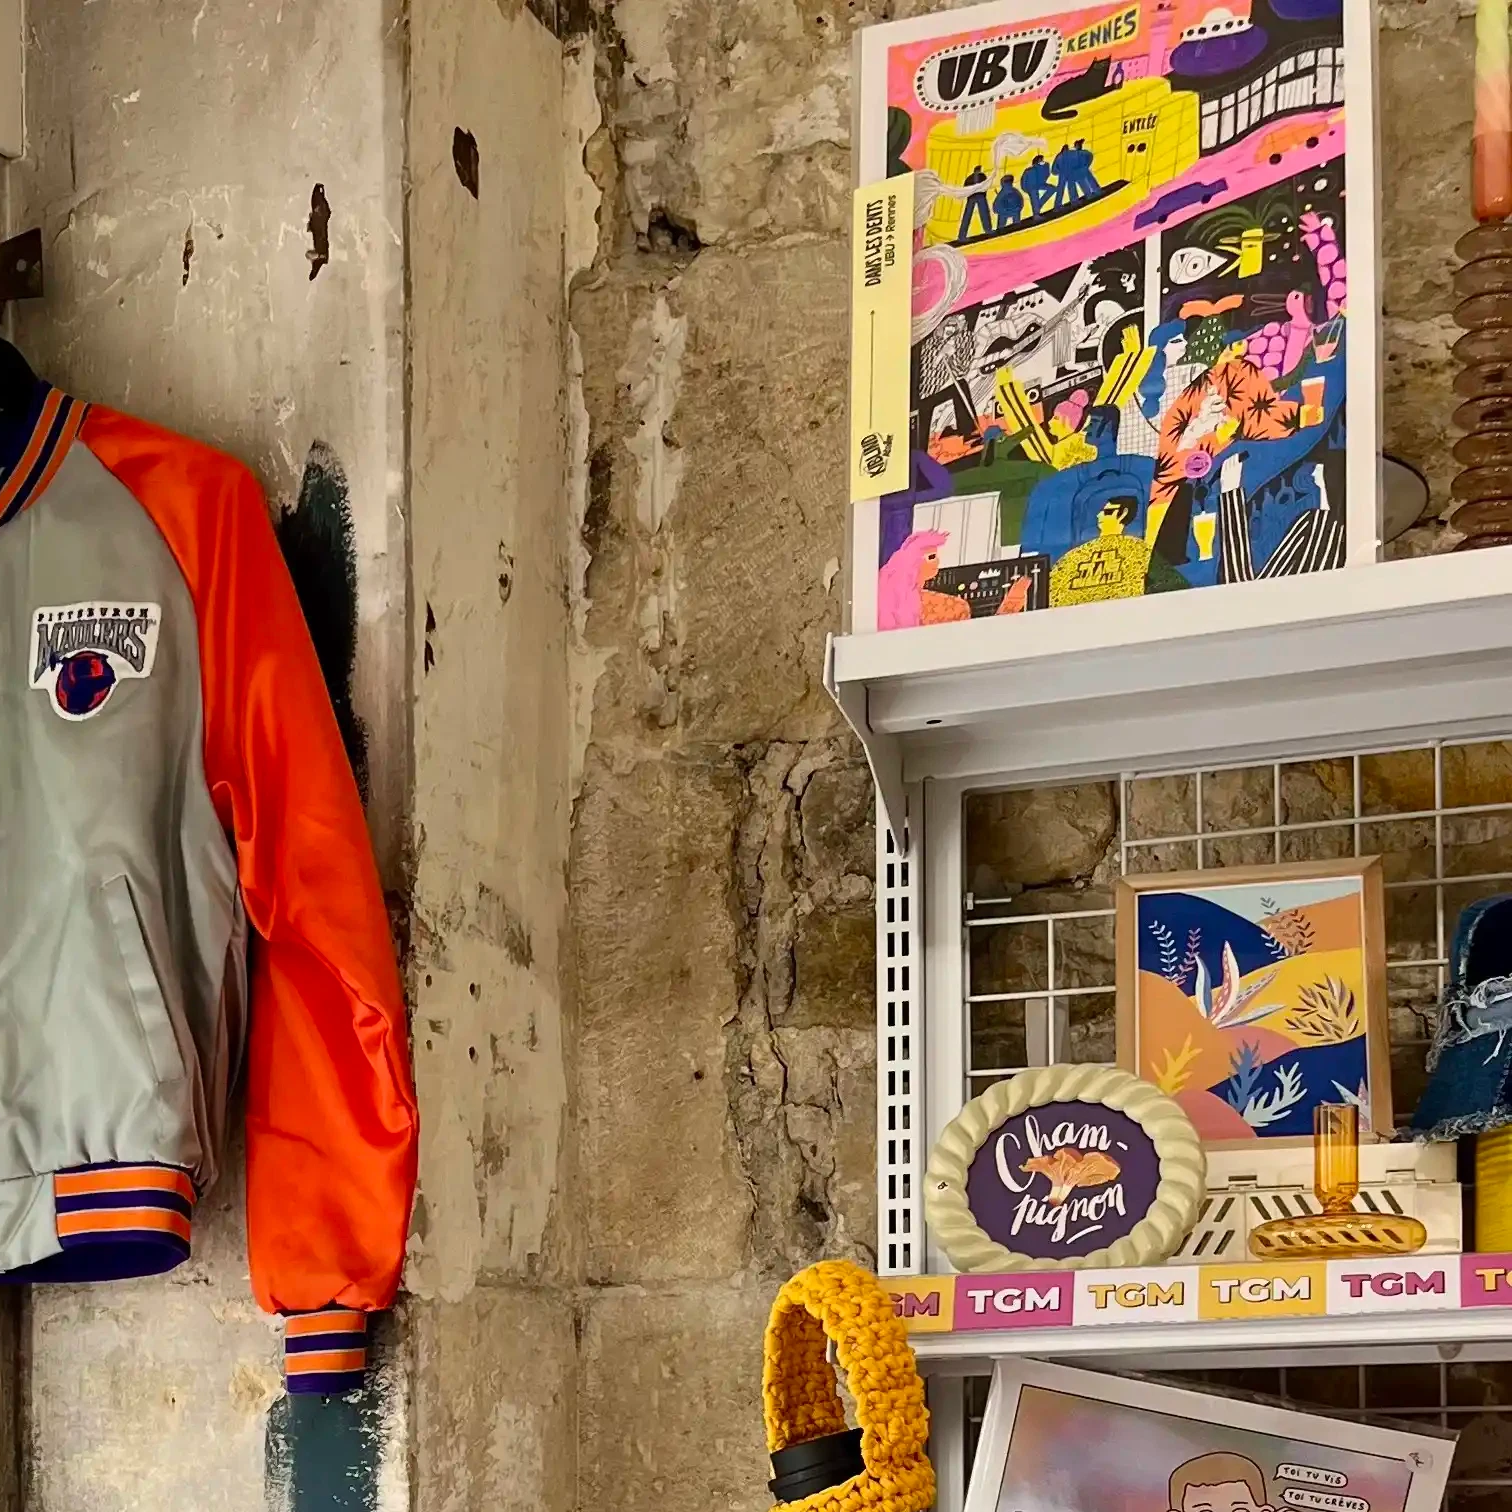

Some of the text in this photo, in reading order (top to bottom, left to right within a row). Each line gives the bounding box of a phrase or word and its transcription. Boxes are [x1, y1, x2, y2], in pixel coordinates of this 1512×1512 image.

[938, 38, 1049, 101] UBU
[864, 199, 883, 287] DANS LES DENTS
[860, 434, 886, 478] KIBLIND
[38, 607, 149, 622] PITTSBURGH
[34, 618, 148, 684] MAULERS
[1010, 1183, 1127, 1242] pignon
[966, 1285, 1059, 1313] TGM
[1088, 1280, 1185, 1309] TGM
[1211, 1275, 1312, 1304] TGM
[1341, 1270, 1445, 1299] TGM
[1306, 1471, 1320, 1480] TU
[1310, 1495, 1322, 1503] TU
